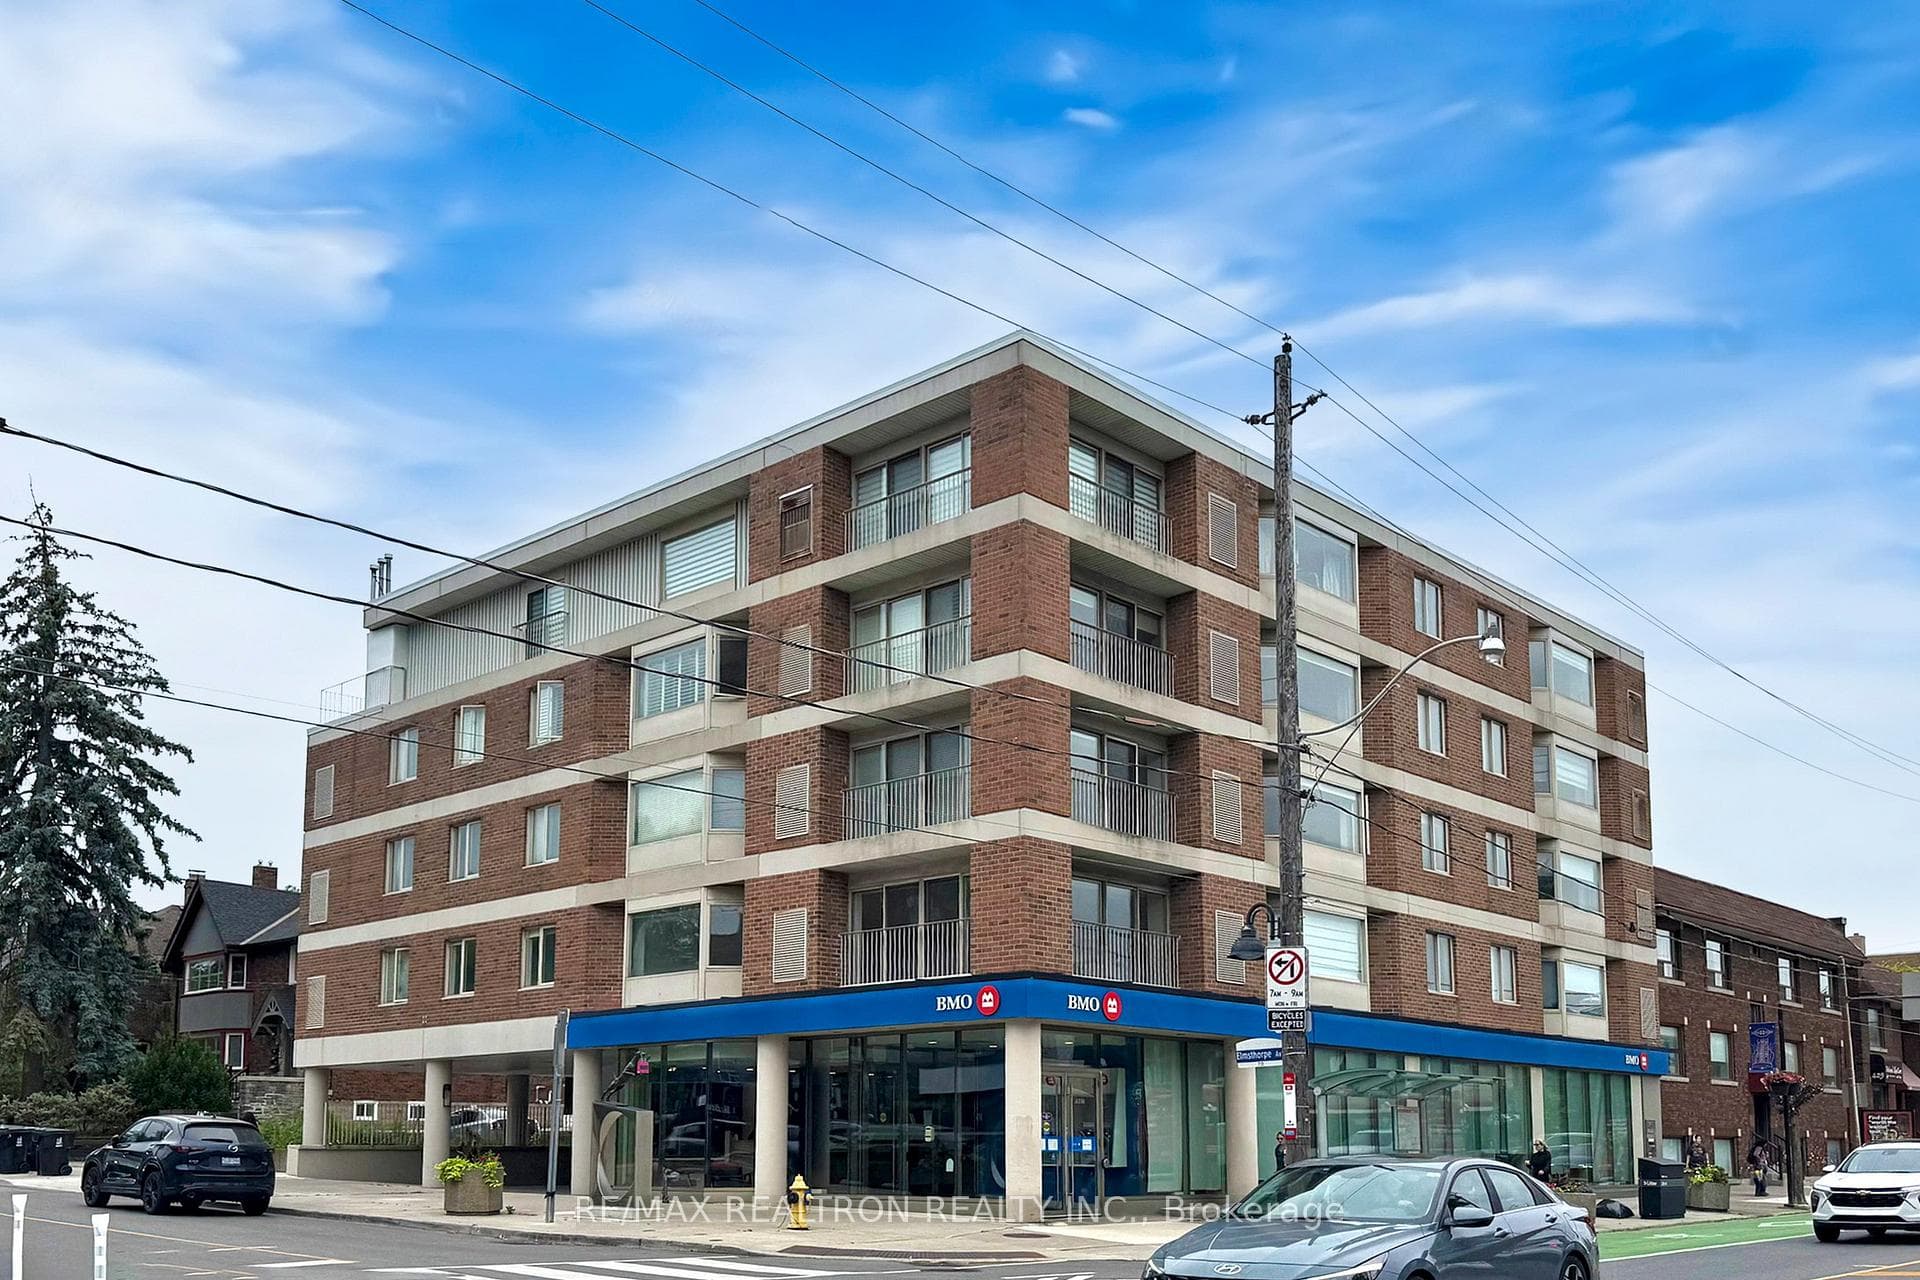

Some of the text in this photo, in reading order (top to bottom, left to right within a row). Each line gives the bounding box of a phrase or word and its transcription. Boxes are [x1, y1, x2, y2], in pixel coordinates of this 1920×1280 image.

[1269, 988, 1281, 997] 7AM
[1290, 988, 1304, 997] 9AM
[936, 994, 973, 1011] BMO
[1067, 994, 1100, 1012] BMO
[1271, 1011, 1304, 1020] BICYCLES
[1271, 1020, 1304, 1028] EXCEPTED
[1236, 1050, 1272, 1060] Elmsthorpe
[1625, 1054, 1640, 1066] BMO
